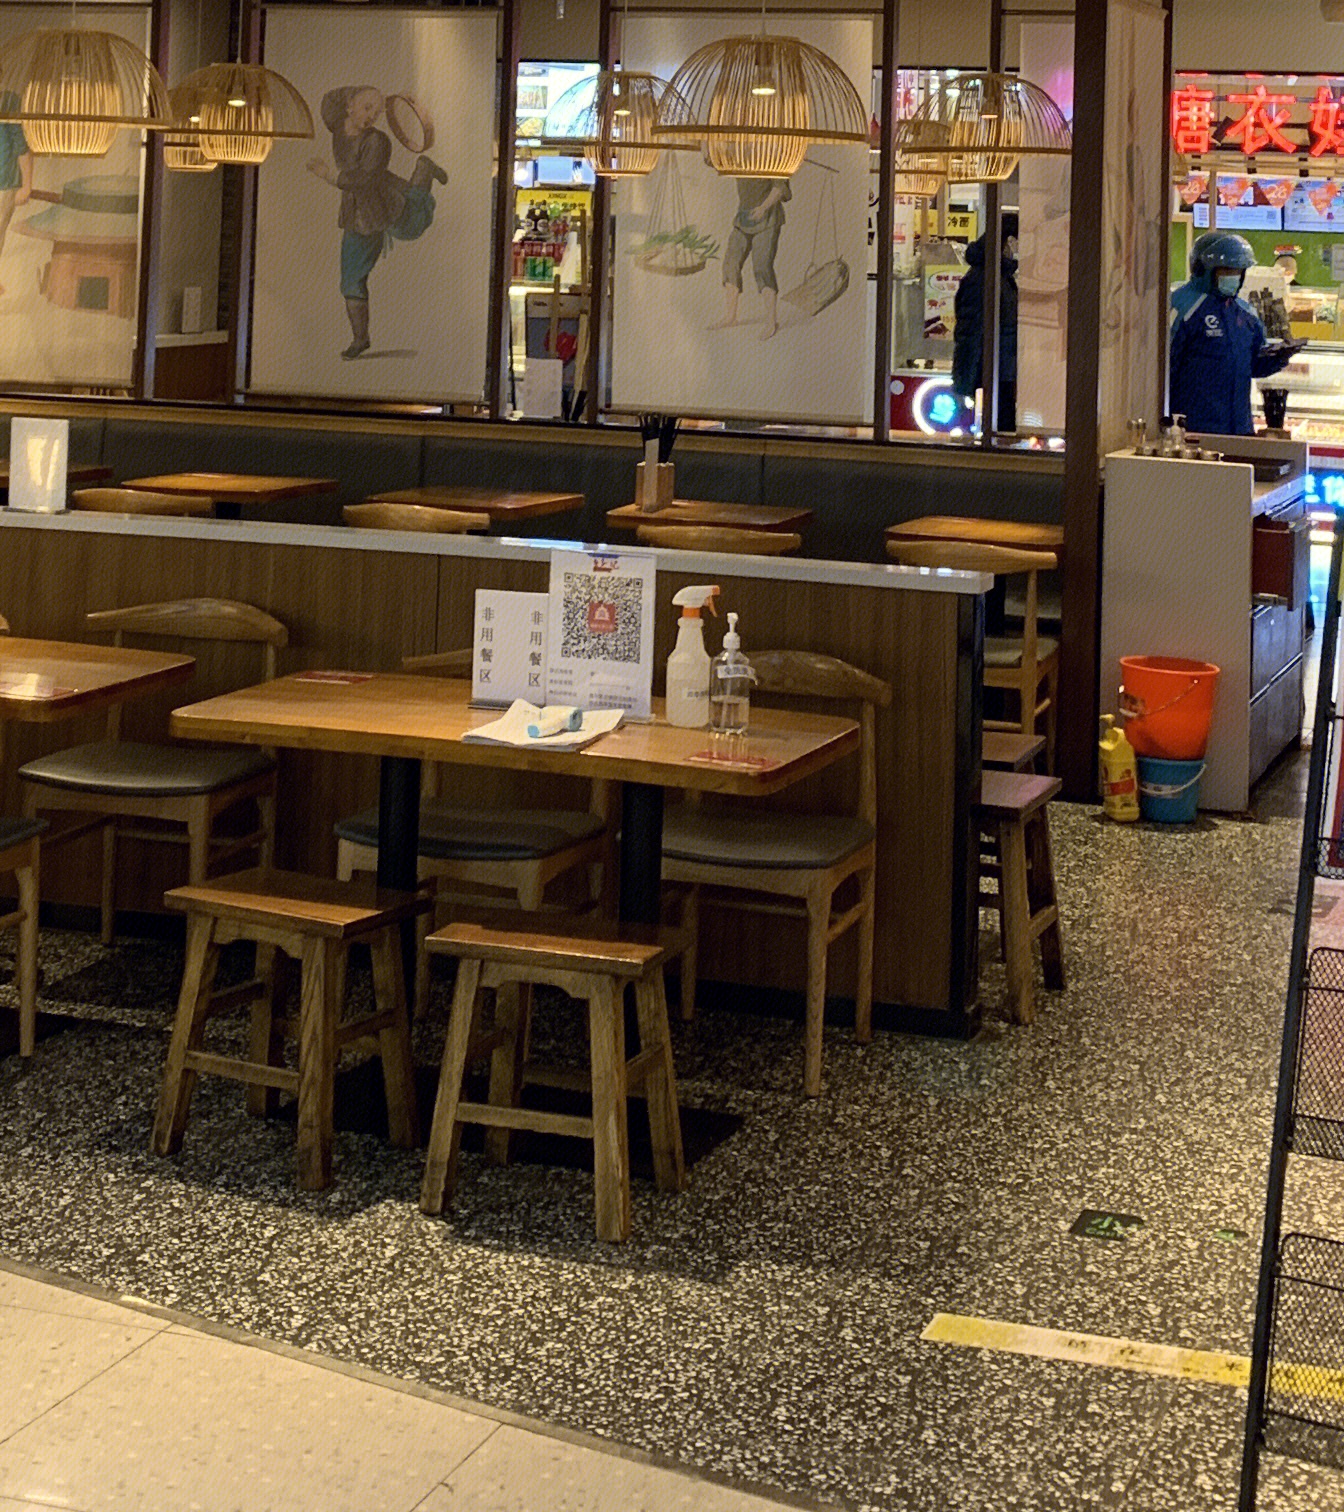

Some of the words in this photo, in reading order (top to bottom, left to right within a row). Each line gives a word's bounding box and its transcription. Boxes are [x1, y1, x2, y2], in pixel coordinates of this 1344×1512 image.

[947, 216, 970, 227] 冷面
[479, 607, 495, 683] 非用餐区
[528, 610, 544, 687] 非用餐区
